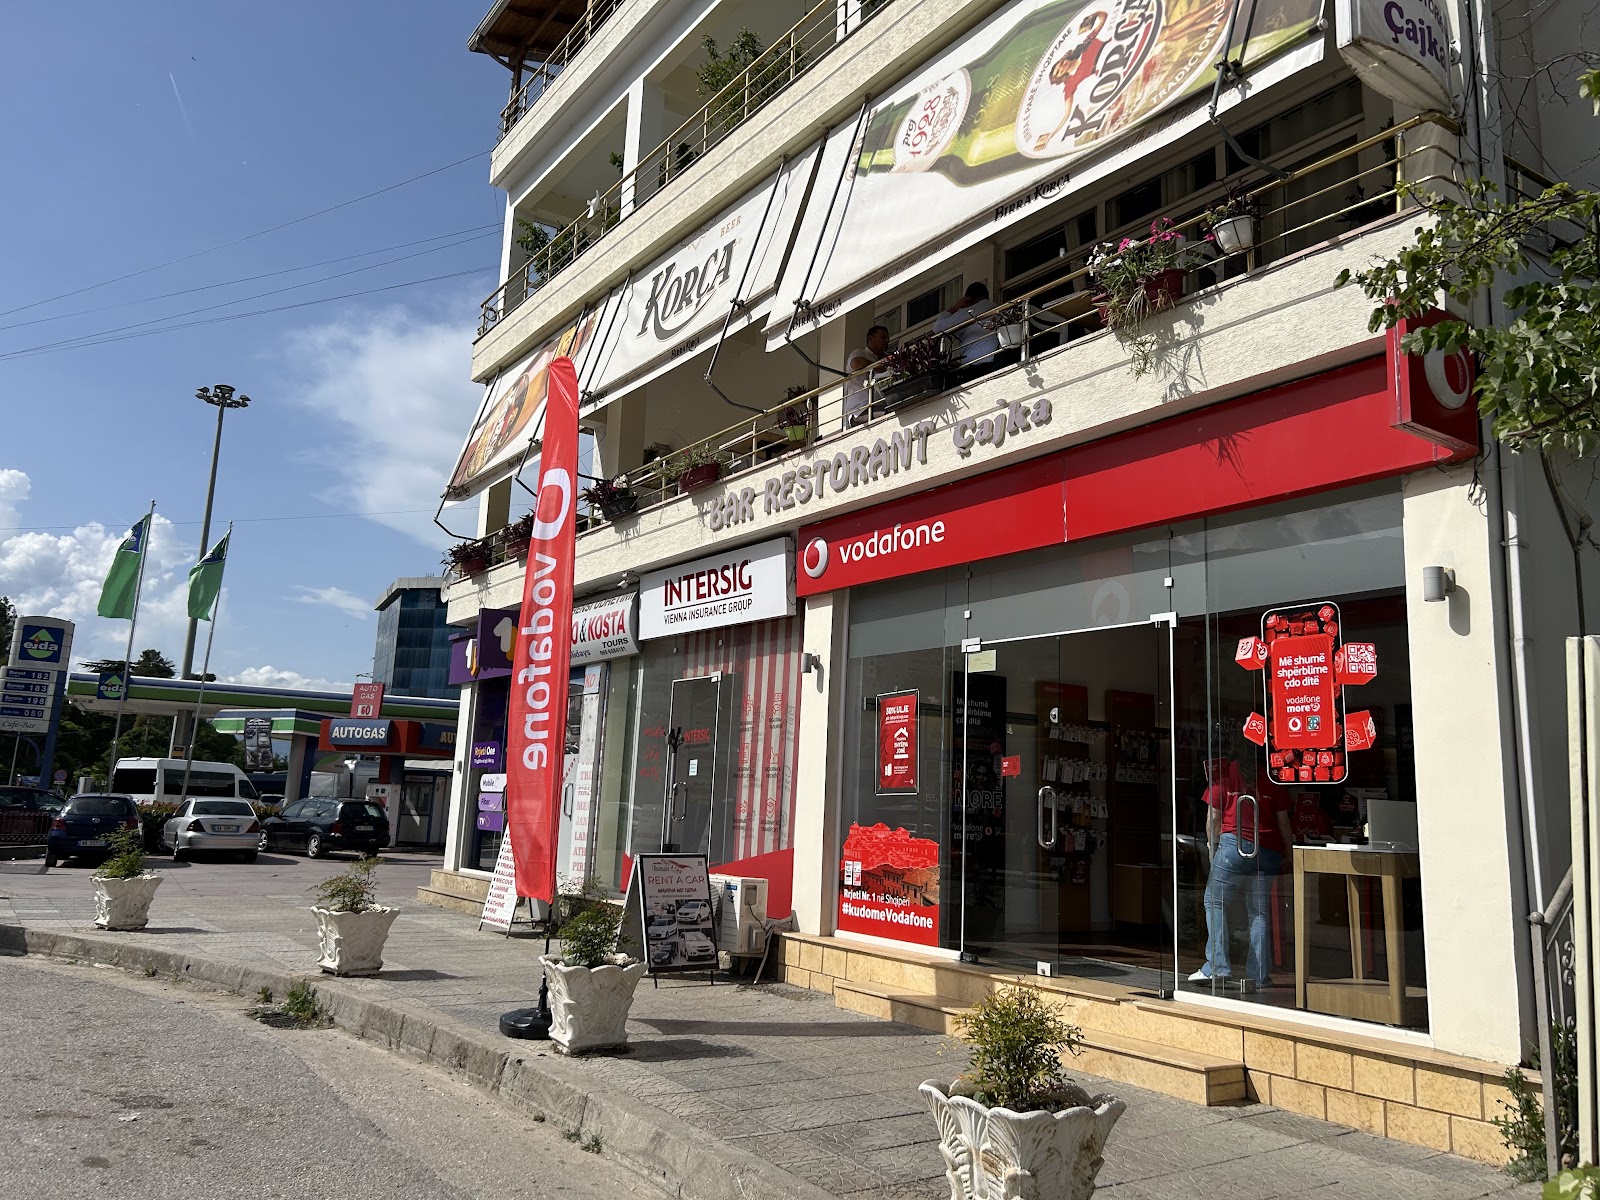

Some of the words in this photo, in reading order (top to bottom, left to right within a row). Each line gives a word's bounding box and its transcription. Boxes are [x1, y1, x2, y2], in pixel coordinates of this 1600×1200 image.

[1384, 1, 1447, 72] Çajka
[909, 95, 941, 158] 1928
[993, 194, 1031, 222] BIRRA
[1033, 173, 1071, 202] KORÇA
[720, 215, 742, 238] BEER
[636, 239, 737, 342] KORÇA
[709, 486, 755, 531] BAR
[763, 421, 937, 515] RESTORANT
[952, 398, 1054, 460] Çajka
[839, 520, 946, 563] vodafone
[664, 559, 753, 607] INTERSIG
[664, 610, 688, 625] VIENNA
[688, 602, 727, 621] INSURANCE
[728, 598, 753, 614] GROUP
[588, 609, 626, 641] KOSTA
[602, 637, 629, 649] TOURS
[1279, 655, 1293, 667] Më
[1293, 652, 1326, 666] shumë
[31, 672, 49, 680] 182
[1277, 665, 1328, 681] shpërblime
[29, 684, 47, 693] 183
[1284, 678, 1301, 690] çdo
[1302, 676, 1320, 687] ditë
[1286, 694, 1321, 705] vodafone
[360, 705, 371, 715] 60
[956, 707, 992, 717] shërblime
[1286, 705, 1311, 713] more
[332, 726, 386, 739] AUTOGAS
[479, 816, 486, 826] TV
[648, 876, 674, 885] RENT
[676, 876, 684, 884] A
[685, 875, 705, 884] CAR
[843, 888, 862, 902] Rrjeti
[862, 891, 872, 902] Nr.
[877, 893, 885, 904] në
[885, 895, 911, 908] Shqipëri
[842, 903, 934, 929] #kudomeVodafone
